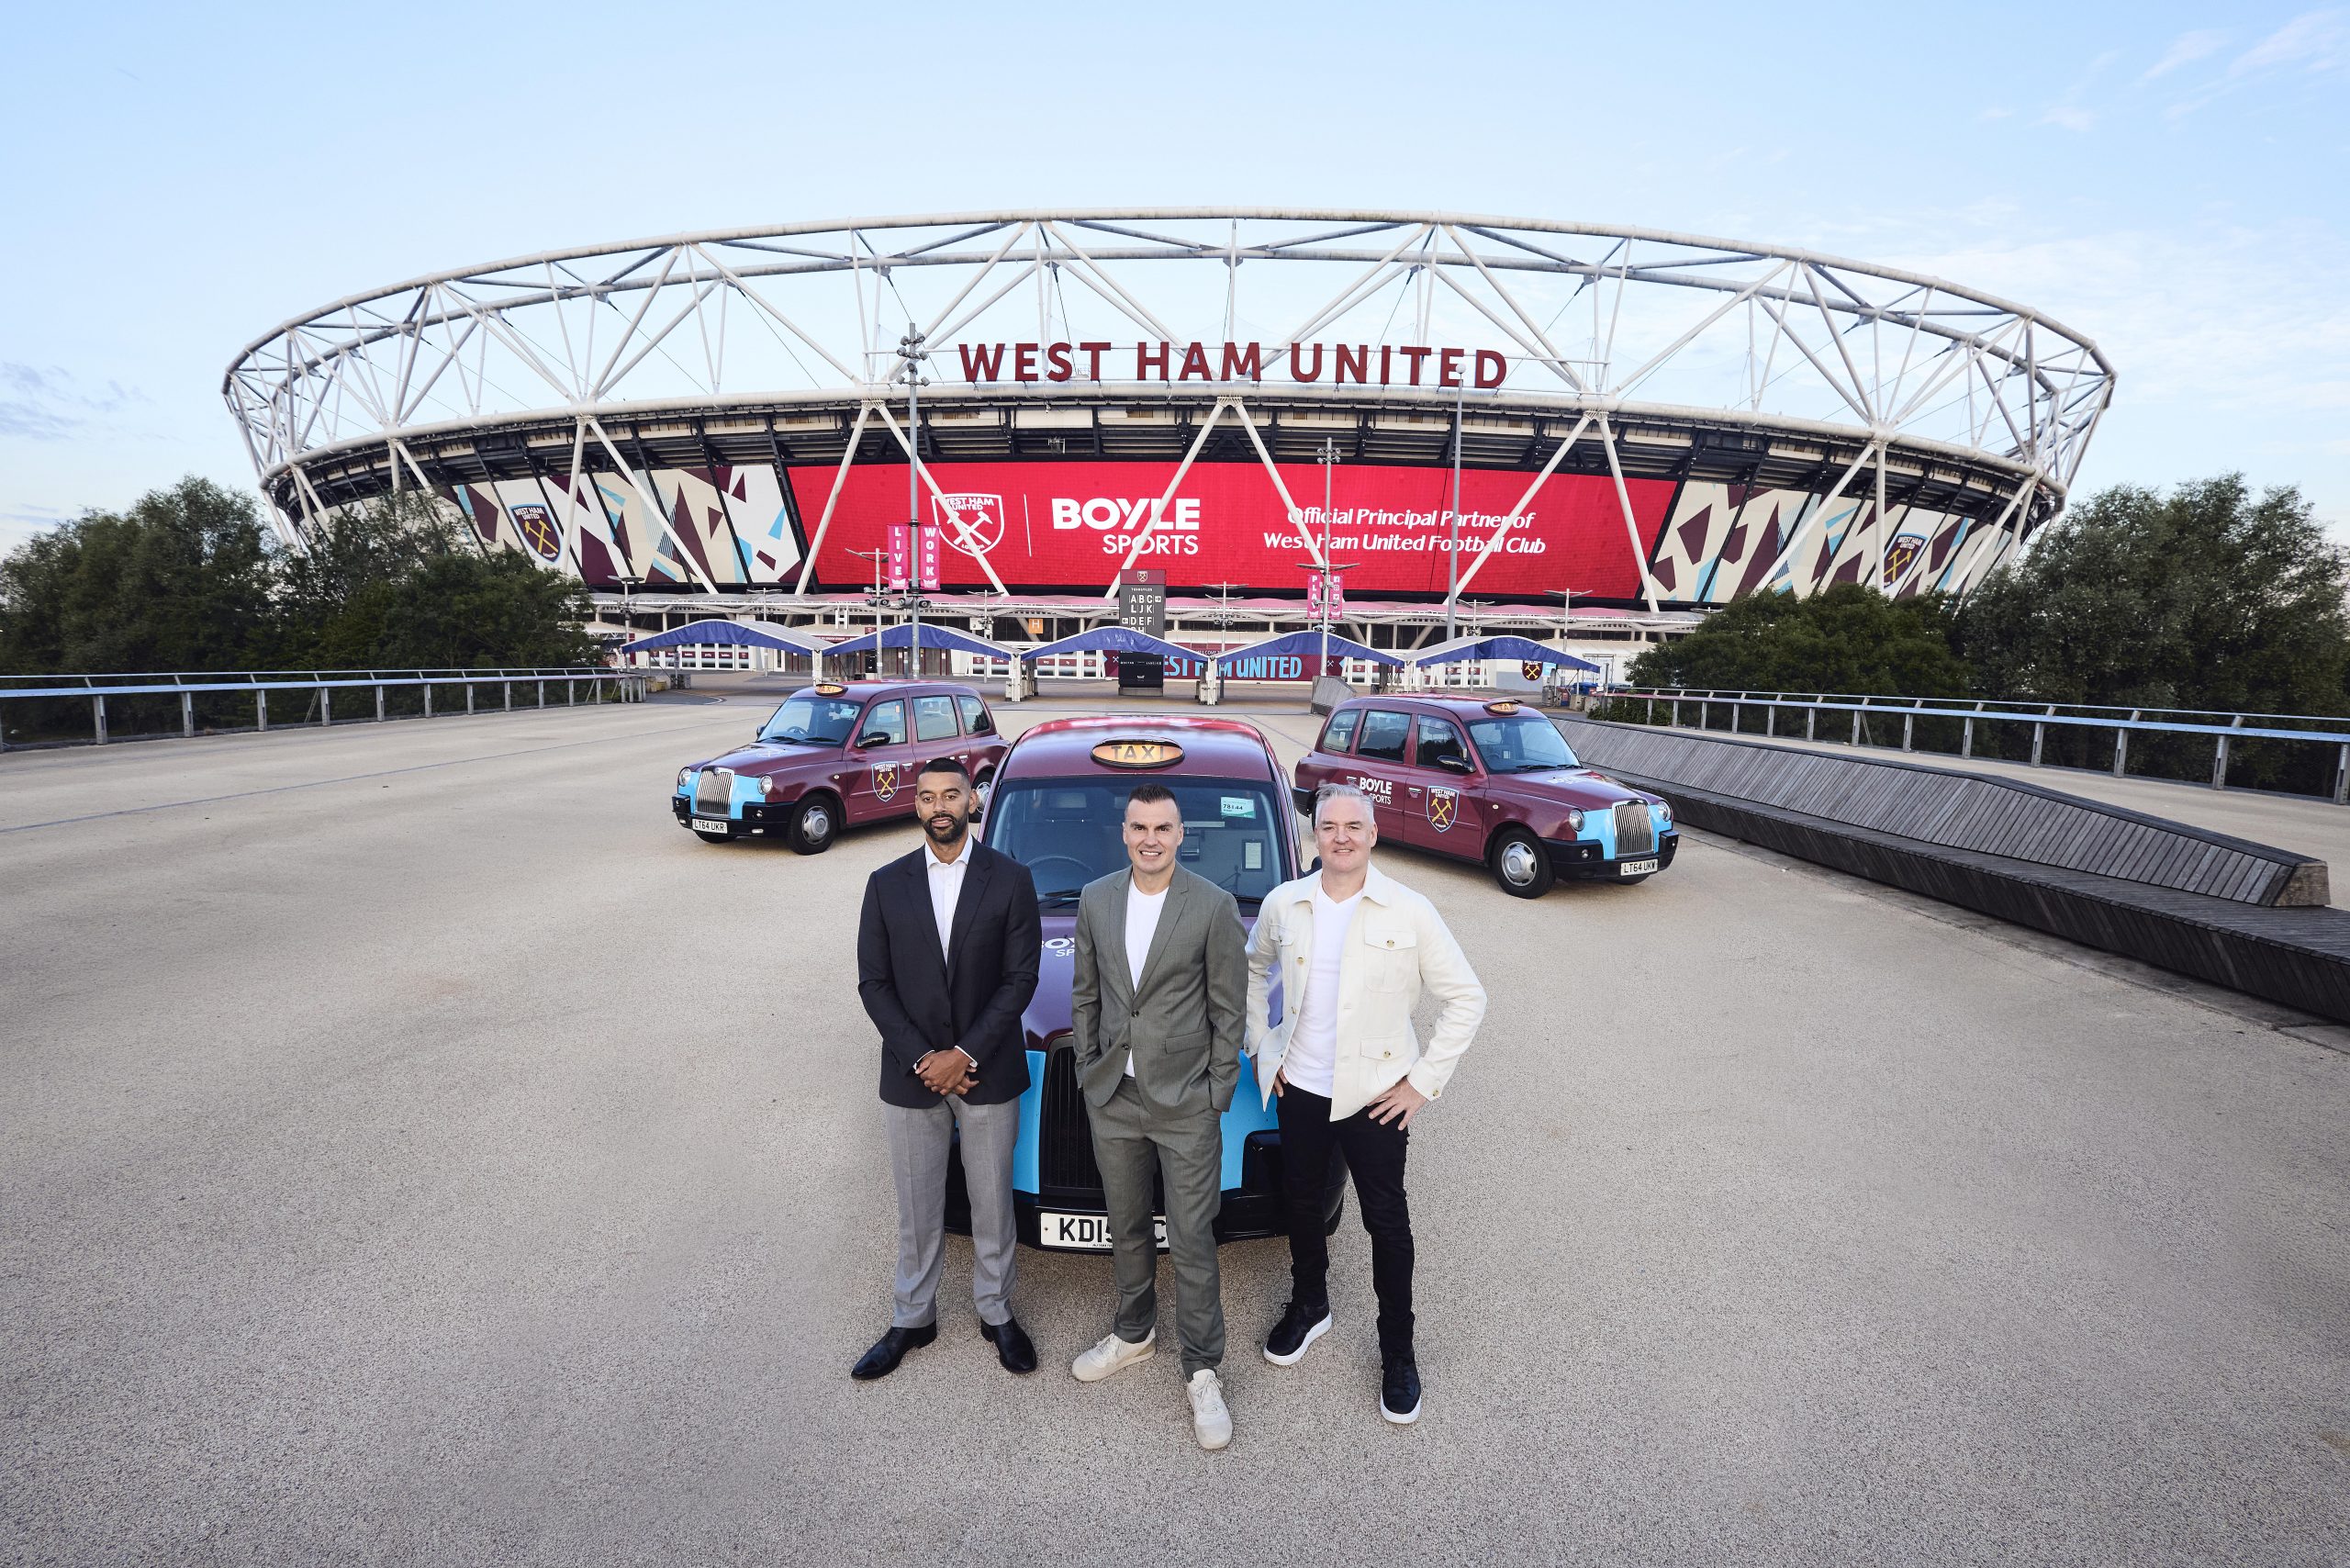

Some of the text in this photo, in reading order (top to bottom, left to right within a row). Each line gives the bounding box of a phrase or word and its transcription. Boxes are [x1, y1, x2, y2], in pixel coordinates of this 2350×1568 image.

[958, 342, 1507, 388] WEST HAM UNITED
[968, 498, 994, 506] HAM
[1051, 498, 1201, 530] BOYLE
[1288, 507, 1353, 525] Official
[1357, 509, 1438, 529] Principal
[1513, 512, 1536, 529] of
[894, 527, 902, 576] LIVE
[924, 528, 936, 577] WORK
[1102, 534, 1199, 554] SPORTS
[1363, 534, 1426, 551] United
[1506, 537, 1546, 554] Club
[1032, 620, 1040, 629] H
[1236, 656, 1303, 678] UNITED
[1111, 745, 1164, 760] TAXI
[1360, 777, 1393, 795] BOYLE
[1370, 793, 1392, 804] SPORTS
[694, 820, 724, 832] LT64 UKR
[1624, 862, 1642, 873] LT64
